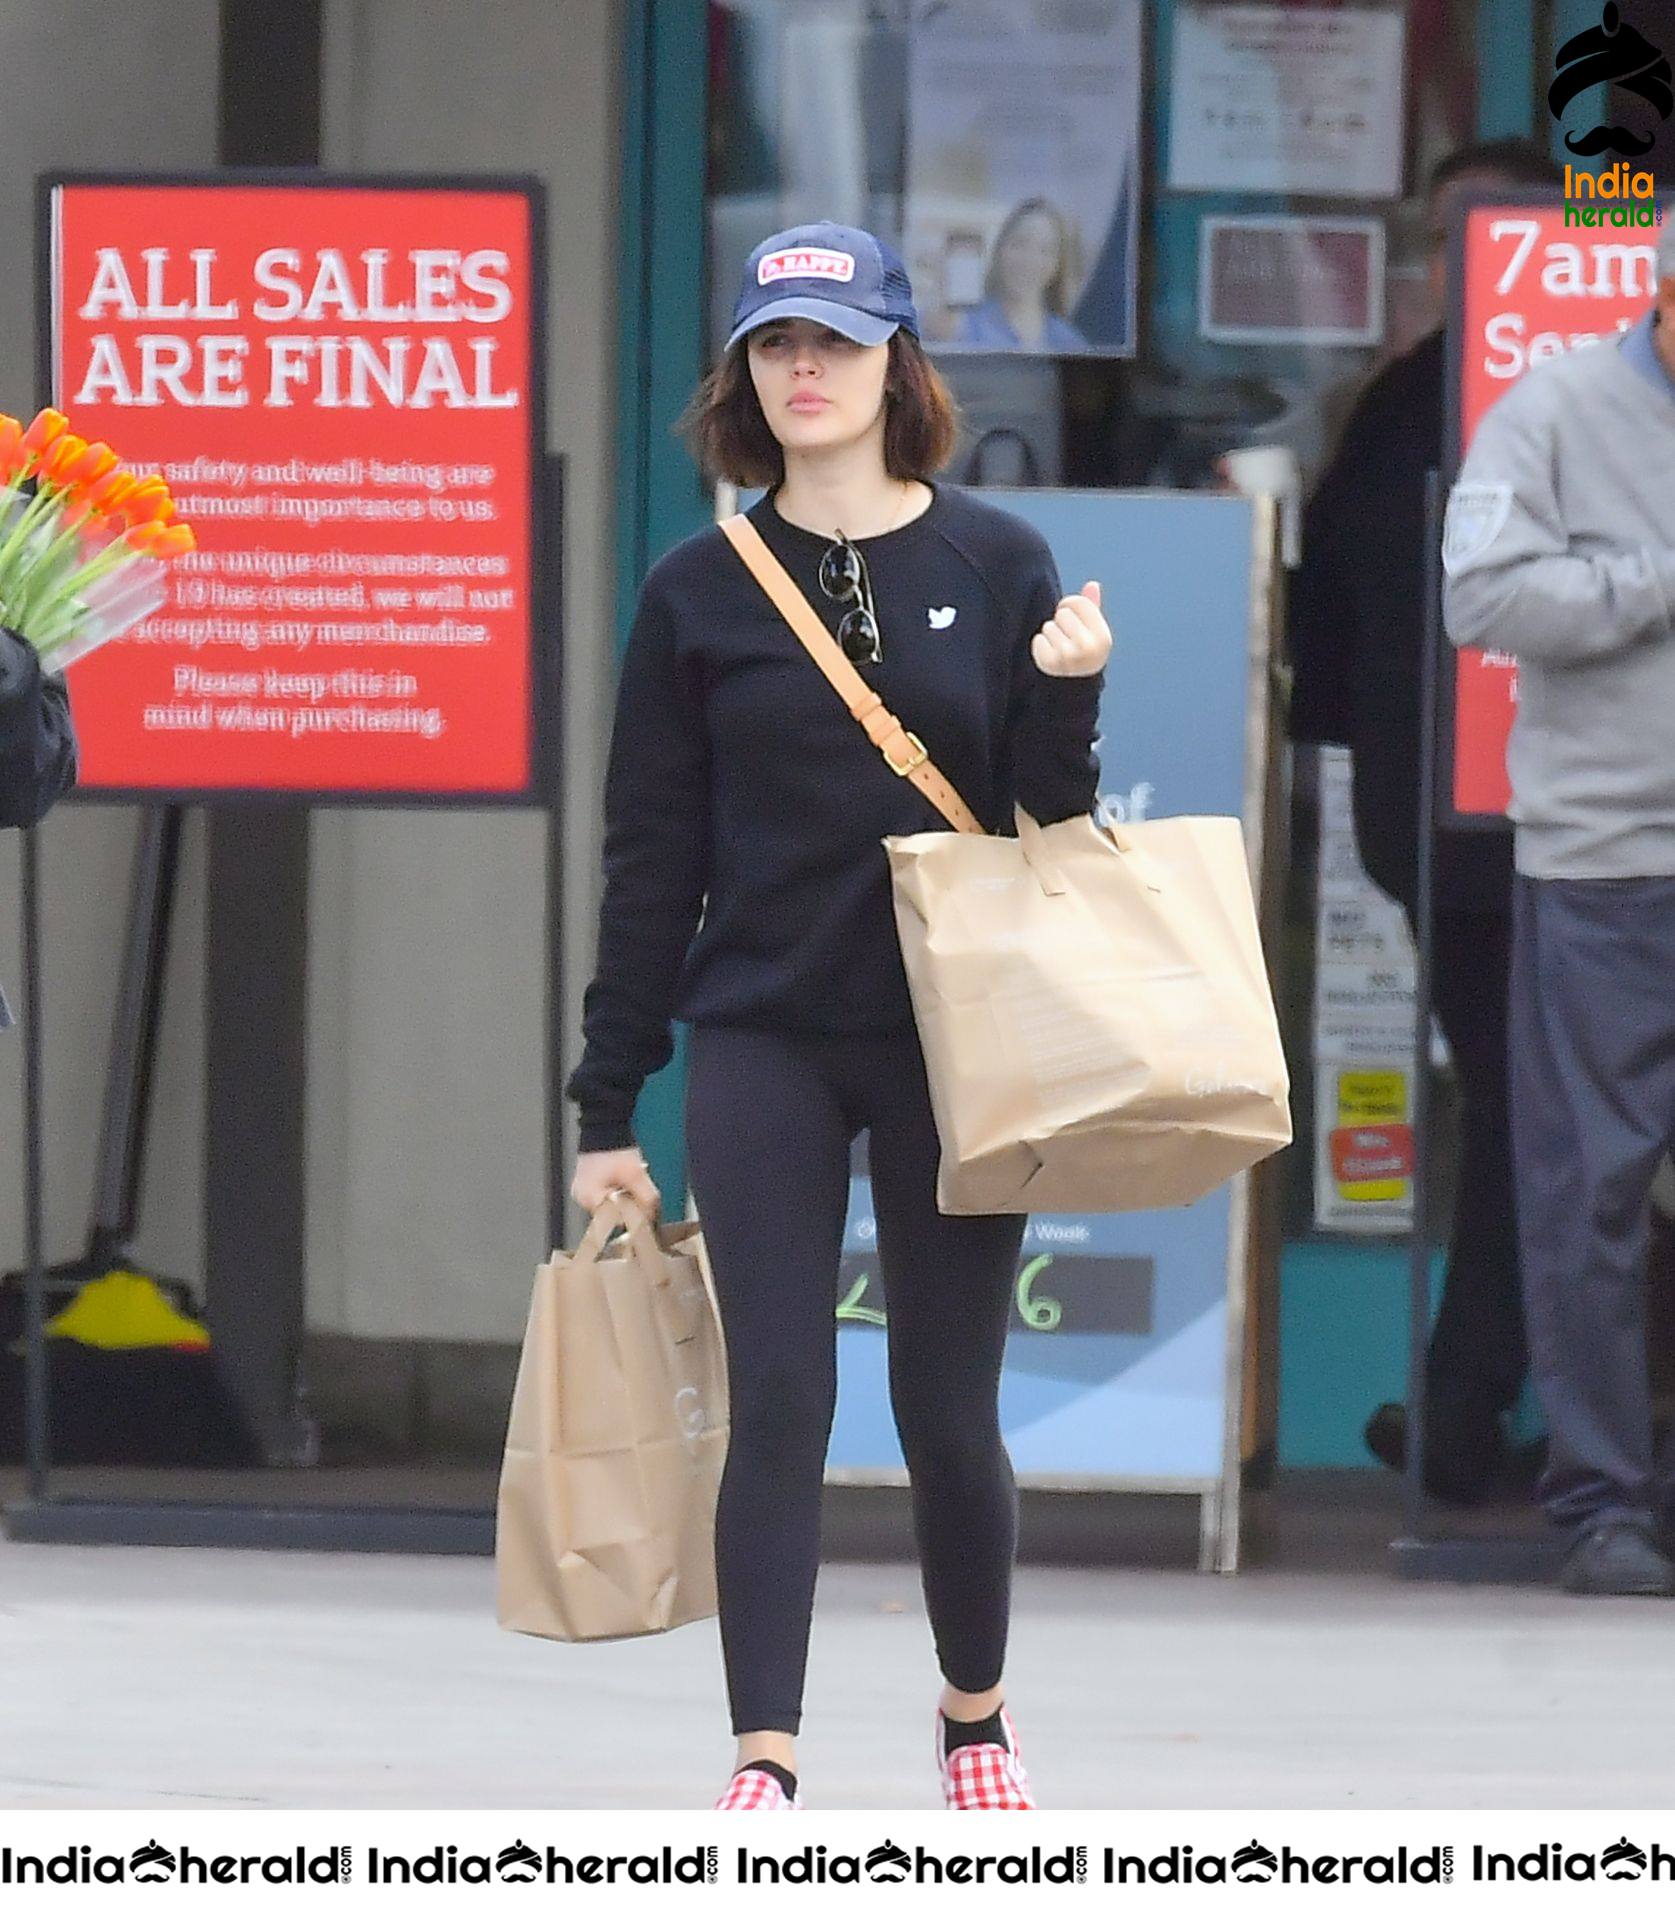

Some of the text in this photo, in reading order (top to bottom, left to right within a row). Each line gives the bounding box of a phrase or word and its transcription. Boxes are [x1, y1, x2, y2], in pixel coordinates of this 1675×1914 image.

[1489, 219, 1658, 296] 7am
[79, 246, 511, 323] ALL SALES
[74, 333, 518, 409] ARE FINAL
[167, 457, 247, 490] safety
[251, 459, 299, 484] and
[449, 464, 496, 486] are
[175, 493, 267, 517] utmost
[271, 492, 426, 526] importance
[429, 496, 457, 520] to
[221, 547, 311, 582] unique
[316, 551, 511, 577] circumstances
[211, 580, 258, 609] has
[373, 588, 413, 611] we
[416, 585, 466, 611] will
[469, 589, 515, 612] not
[133, 614, 262, 651] accepting
[265, 619, 313, 650] any
[172, 664, 418, 704] Please keep this in
[143, 701, 213, 731] mind
[216, 704, 285, 732] when
